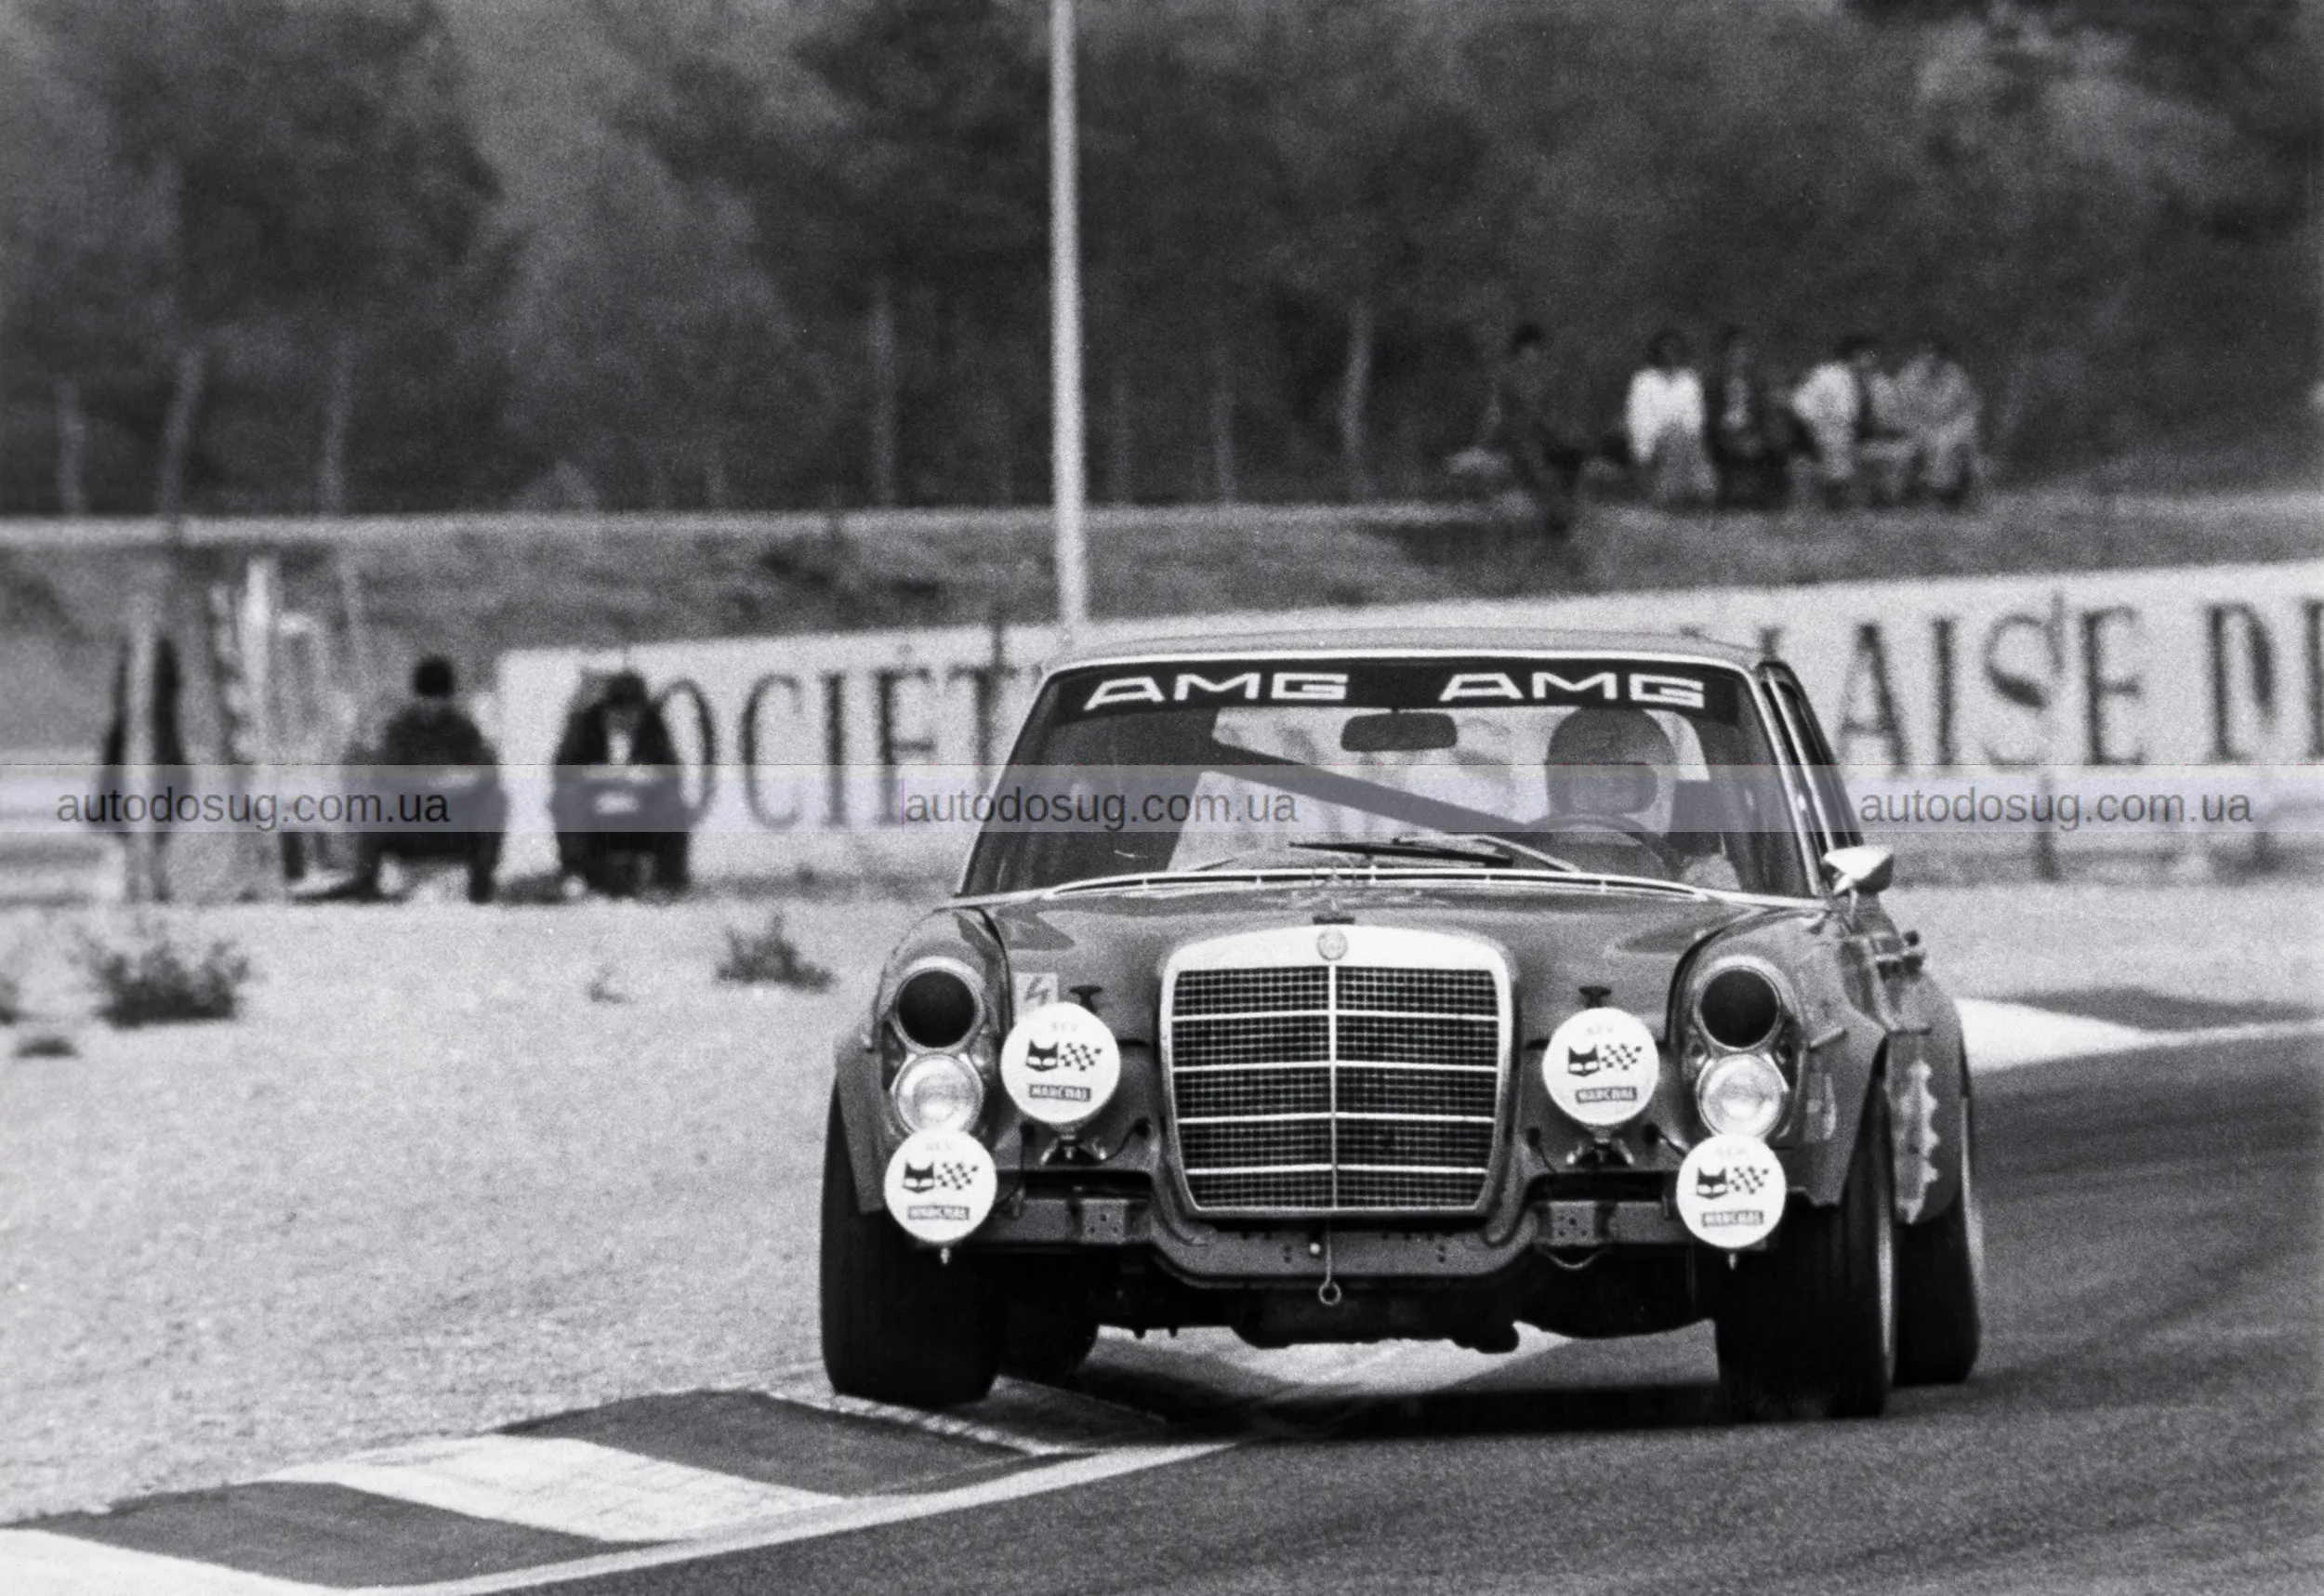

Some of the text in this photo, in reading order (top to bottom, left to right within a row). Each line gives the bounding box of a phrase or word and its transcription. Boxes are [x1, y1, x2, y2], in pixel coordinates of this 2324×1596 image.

[1083, 672, 1349, 711] AMG
[1438, 671, 1705, 709] AMG
[1755, 602, 2143, 772] AISE
[651, 661, 1043, 829] OCIET
